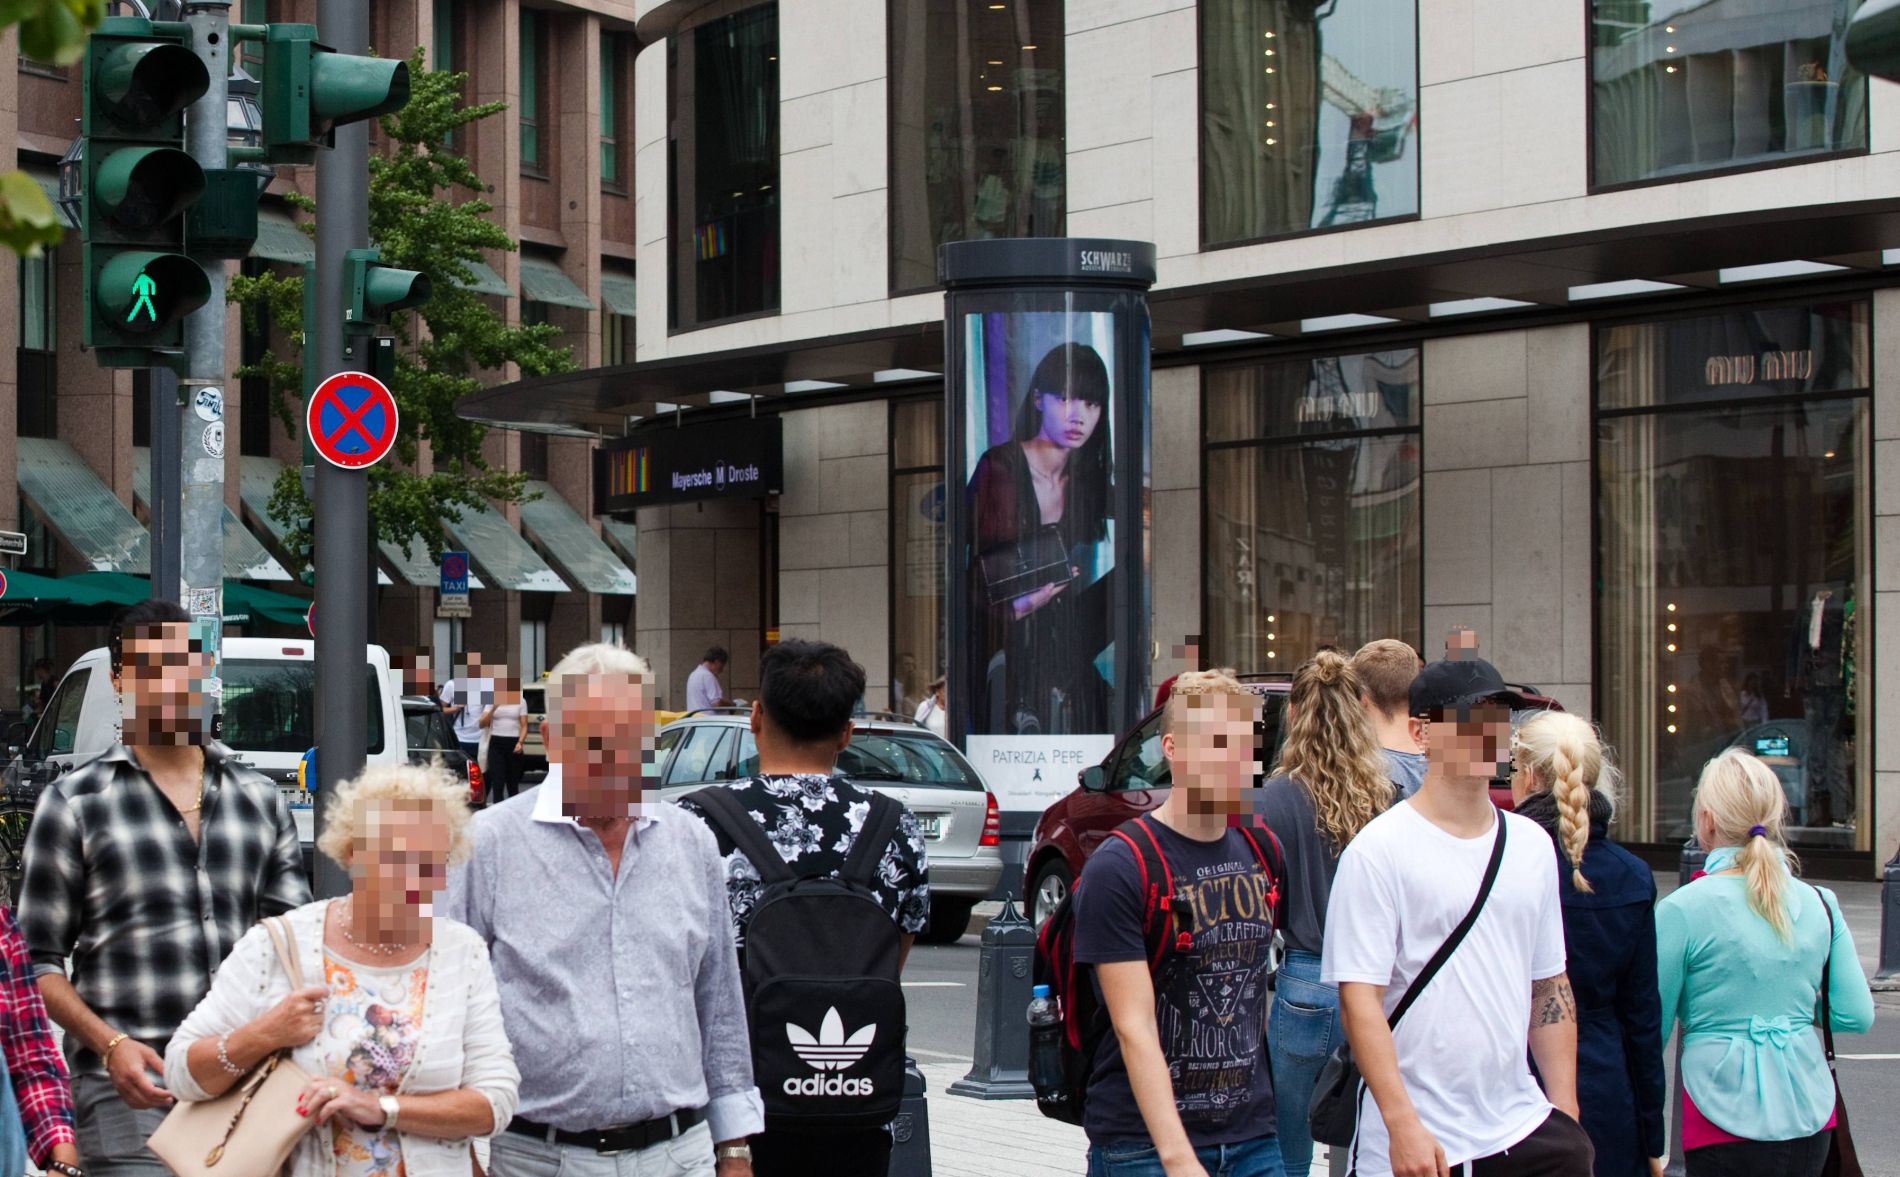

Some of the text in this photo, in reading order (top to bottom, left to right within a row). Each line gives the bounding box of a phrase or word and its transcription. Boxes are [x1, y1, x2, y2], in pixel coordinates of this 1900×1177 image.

[672, 469, 712, 491] Mayersche
[728, 464, 759, 482] Droste
[443, 581, 466, 591] TAXI
[992, 749, 1084, 764] PATRIZIA PEPE
[1196, 861, 1245, 877] ORIGINAL
[783, 1073, 874, 1096] adidas
